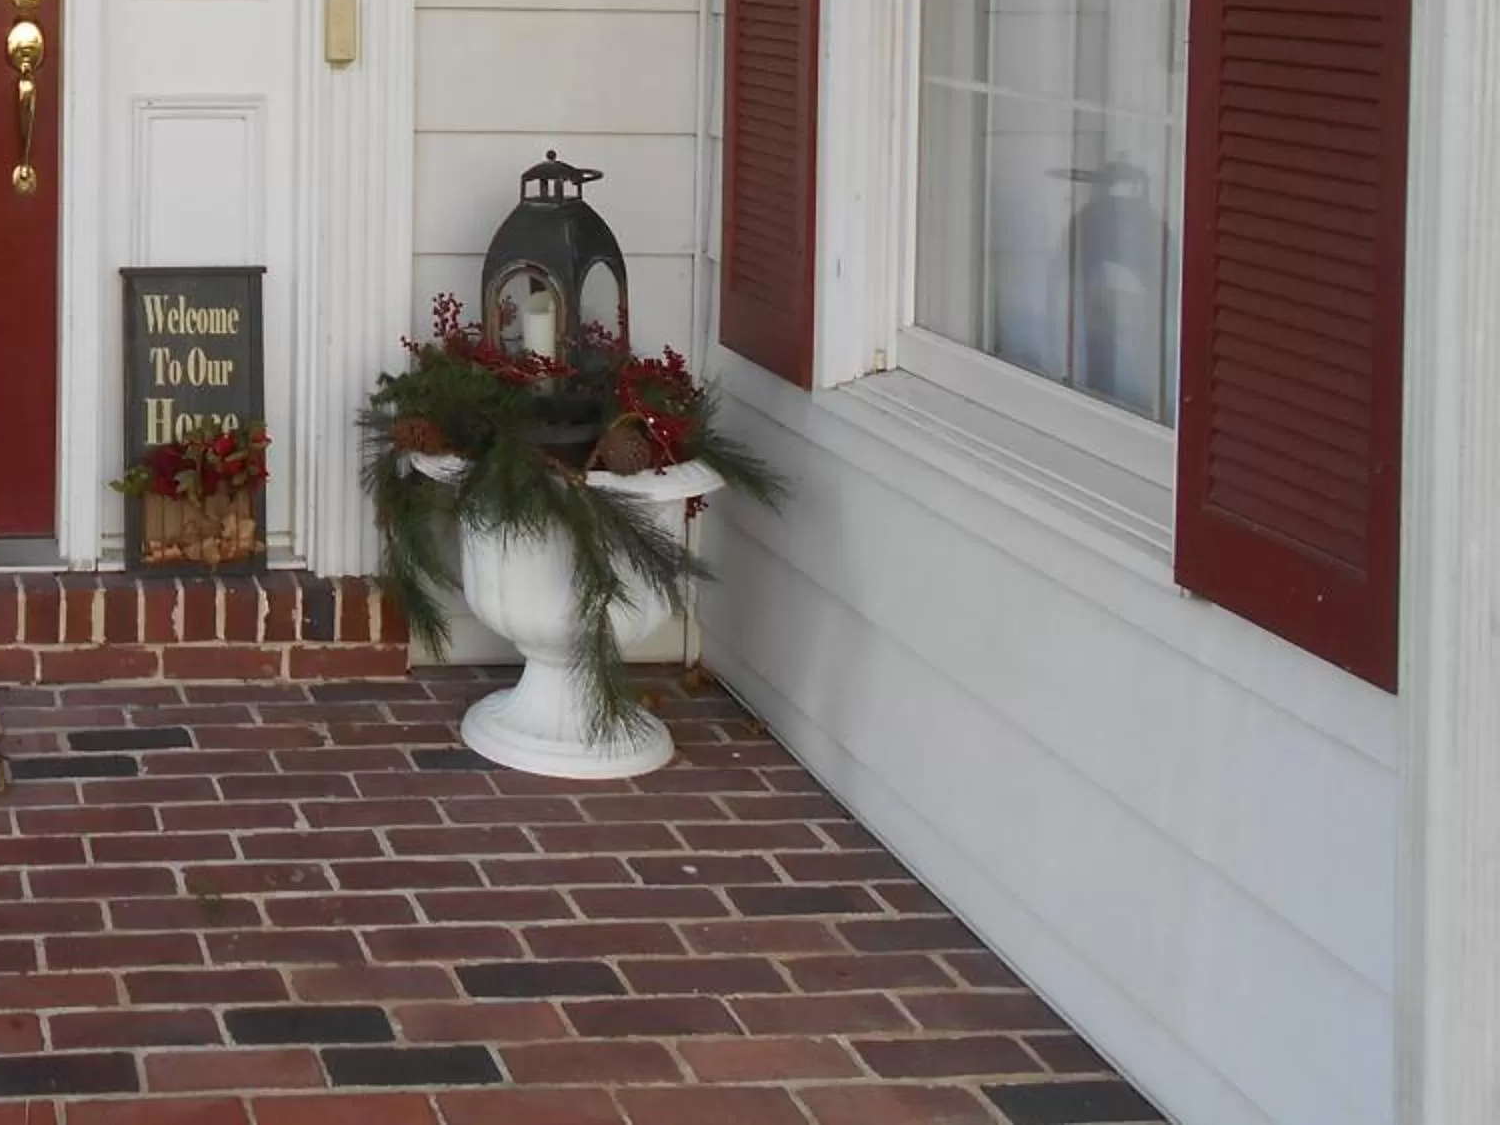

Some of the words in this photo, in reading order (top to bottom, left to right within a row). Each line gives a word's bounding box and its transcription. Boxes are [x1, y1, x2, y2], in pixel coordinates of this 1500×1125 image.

[143, 294, 240, 334] Welcome
[150, 347, 182, 386] To
[187, 346, 233, 386] Our
[143, 397, 240, 445] Hoe
